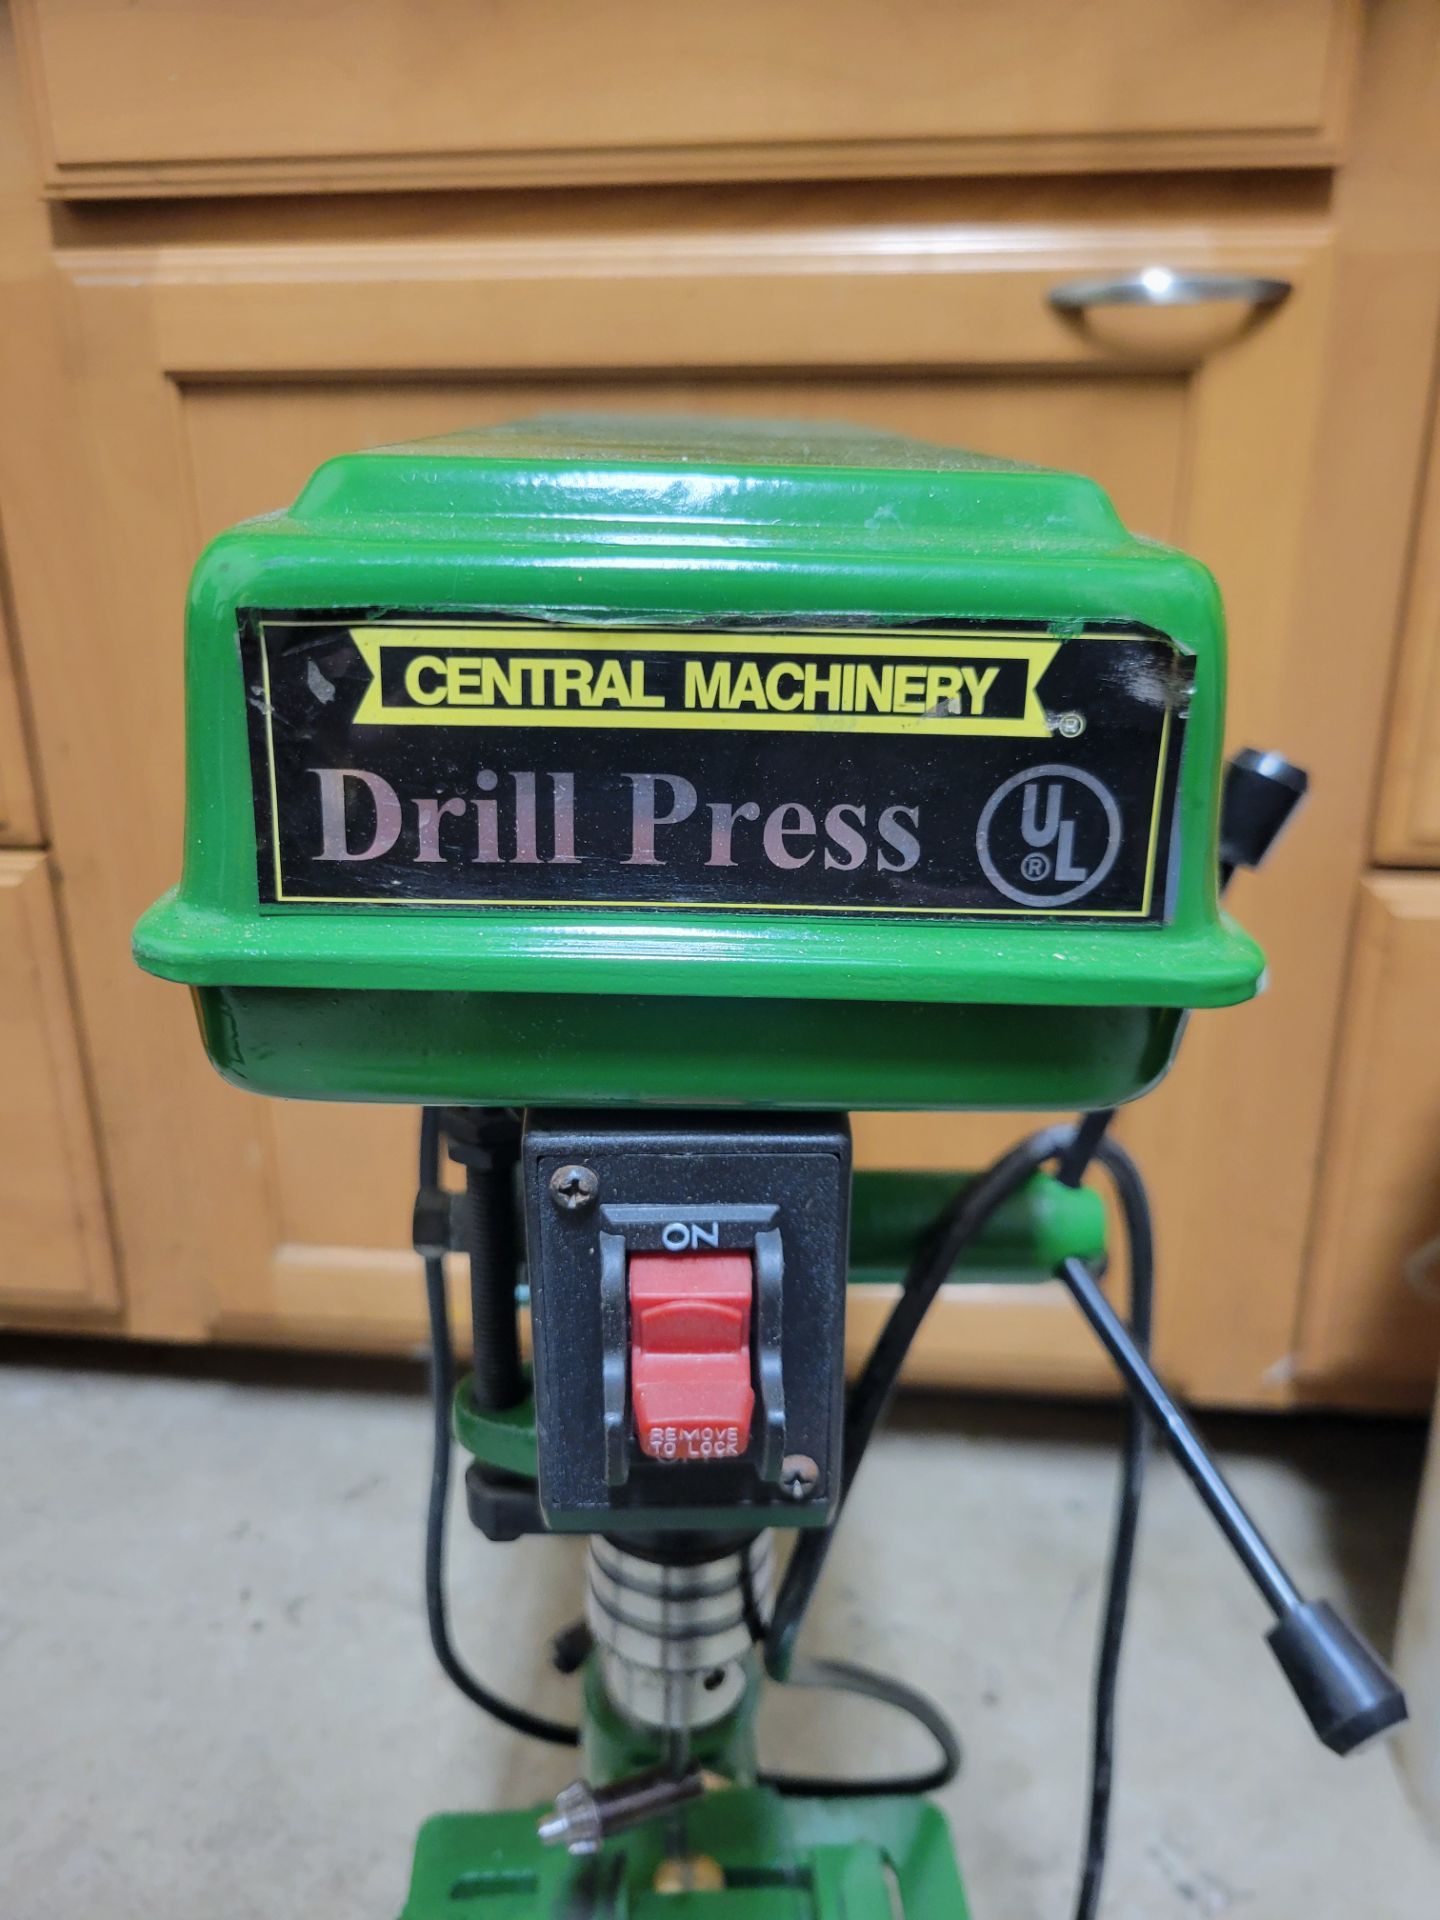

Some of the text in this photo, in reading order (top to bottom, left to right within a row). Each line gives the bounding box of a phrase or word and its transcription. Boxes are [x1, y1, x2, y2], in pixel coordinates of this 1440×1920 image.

[404, 655, 1000, 715] CENTRAL MACHINERY
[307, 768, 921, 872] Drill Press
[662, 1221, 719, 1251] ON
[650, 1426, 738, 1441] REMOVE
[651, 1440, 738, 1457] TO LOCK
